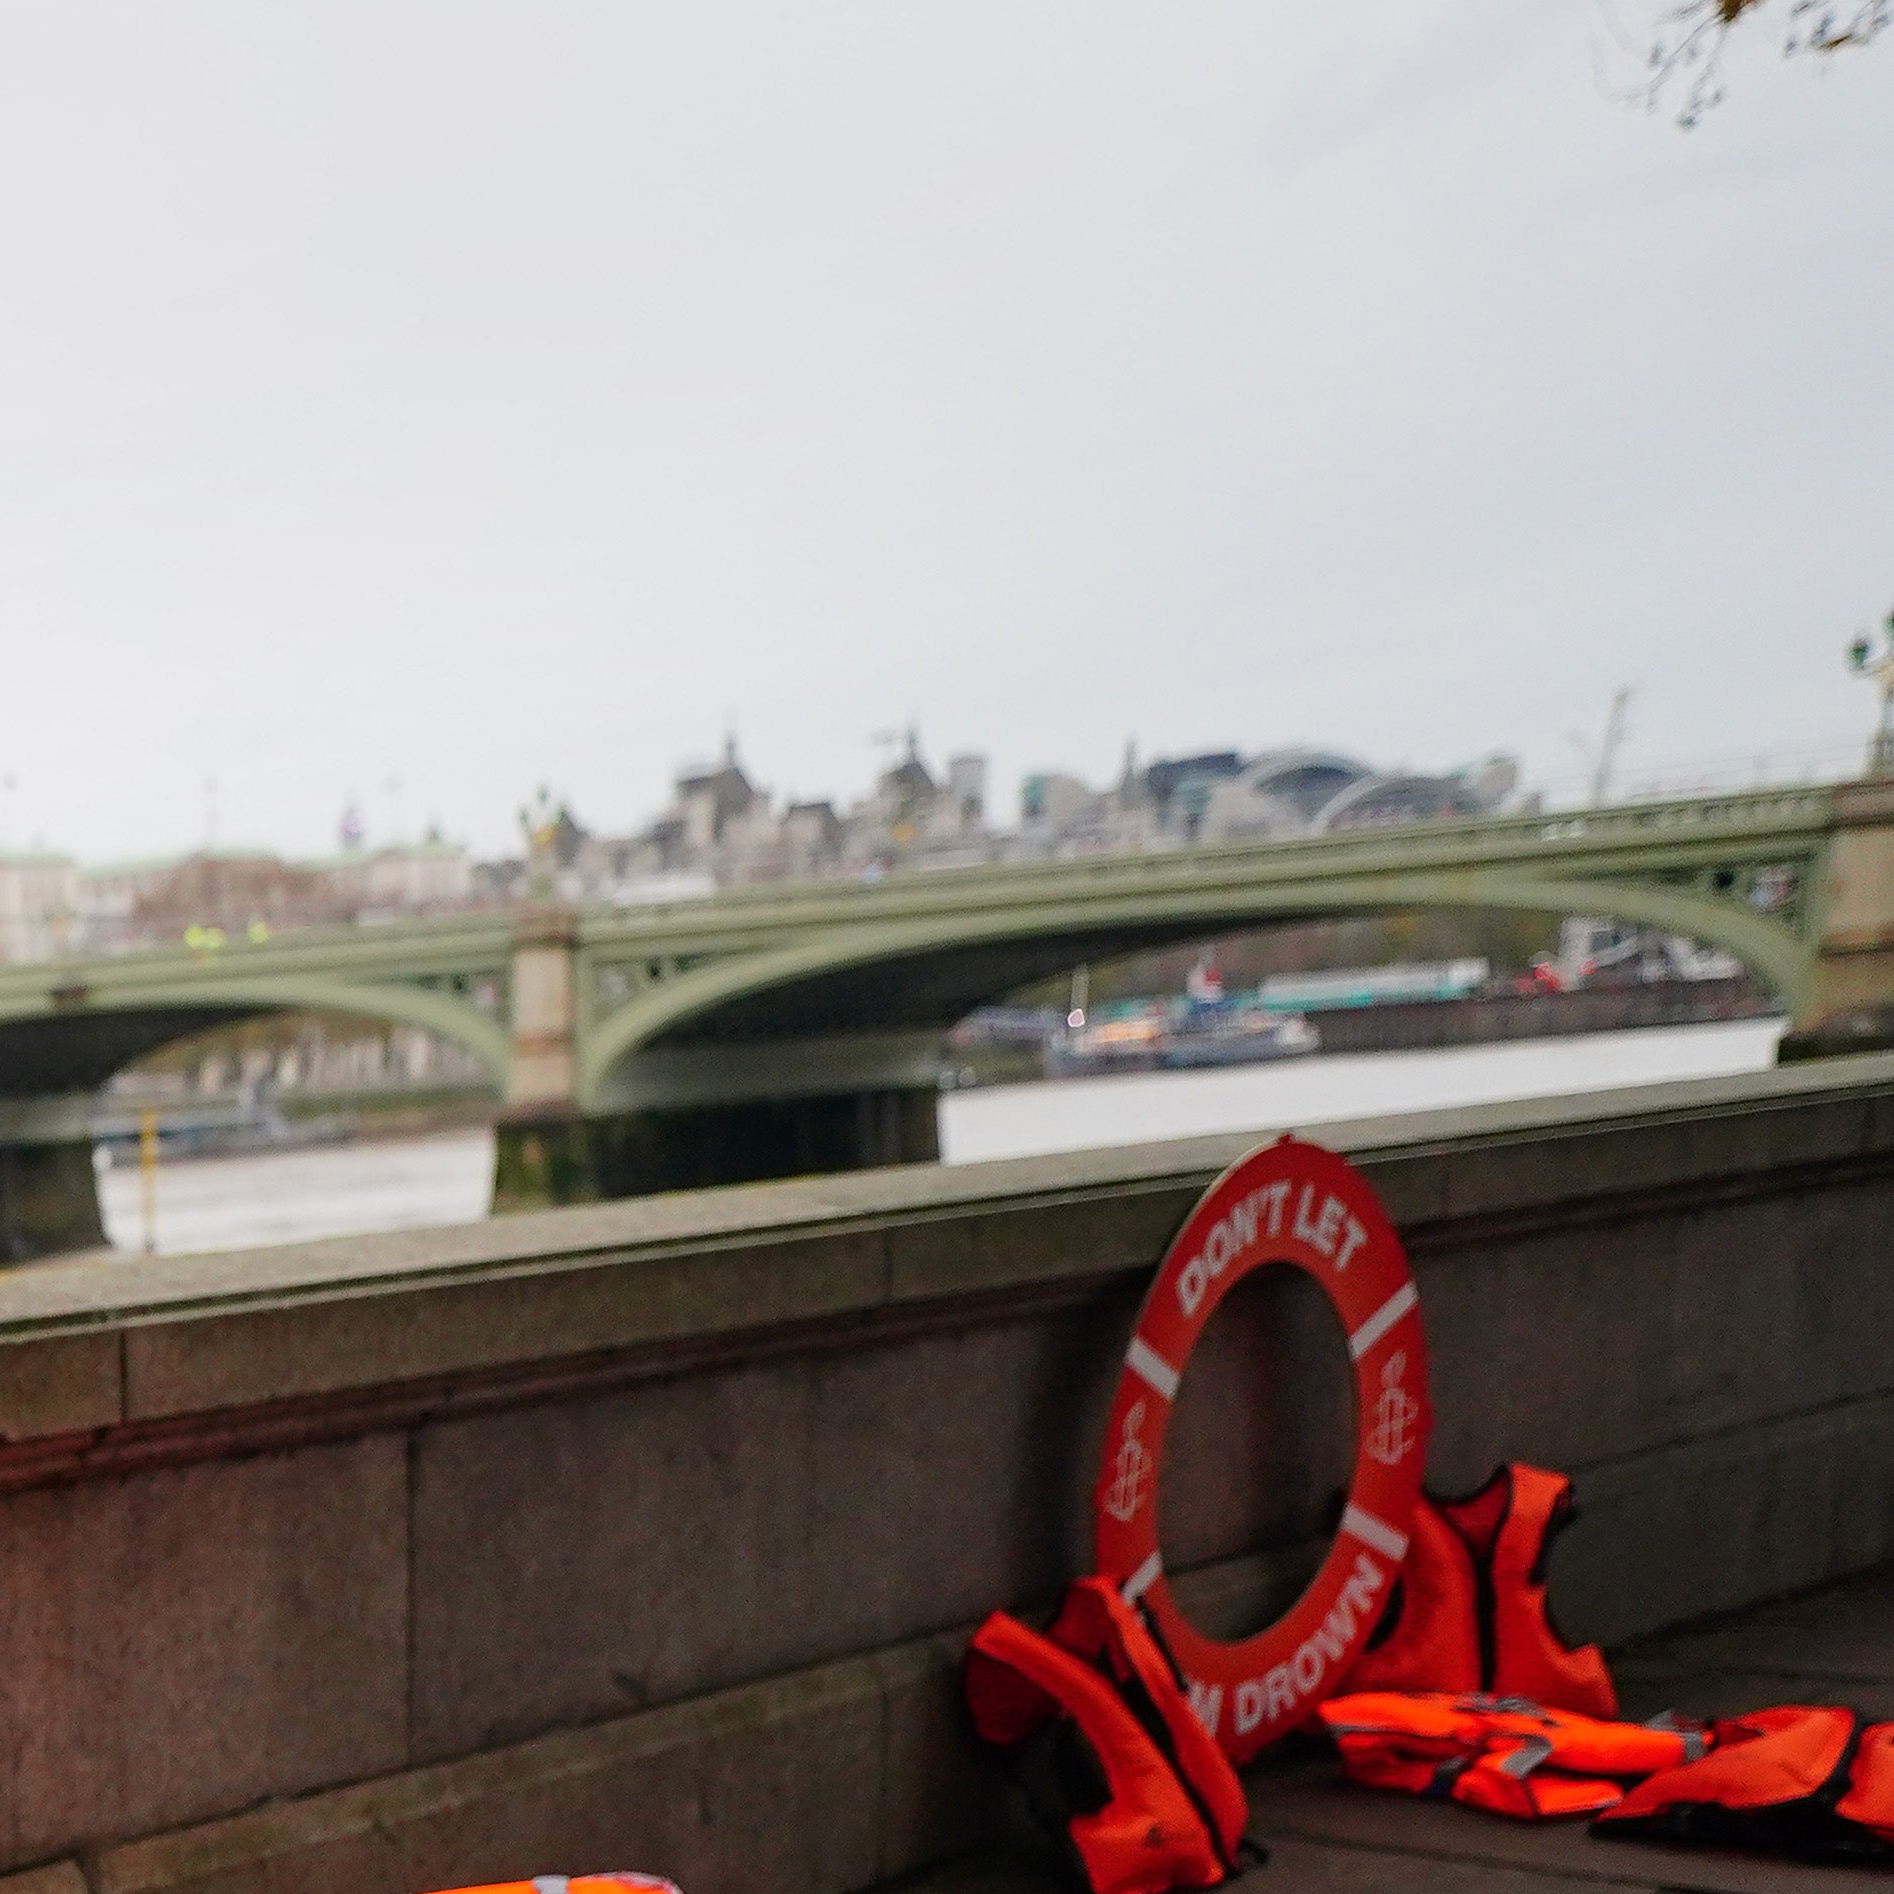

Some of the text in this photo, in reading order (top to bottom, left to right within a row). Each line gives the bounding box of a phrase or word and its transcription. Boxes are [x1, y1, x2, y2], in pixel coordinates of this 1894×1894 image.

[1175, 1179, 1368, 1318] DON'T LET
[1232, 1553, 1385, 1737] DROWN
